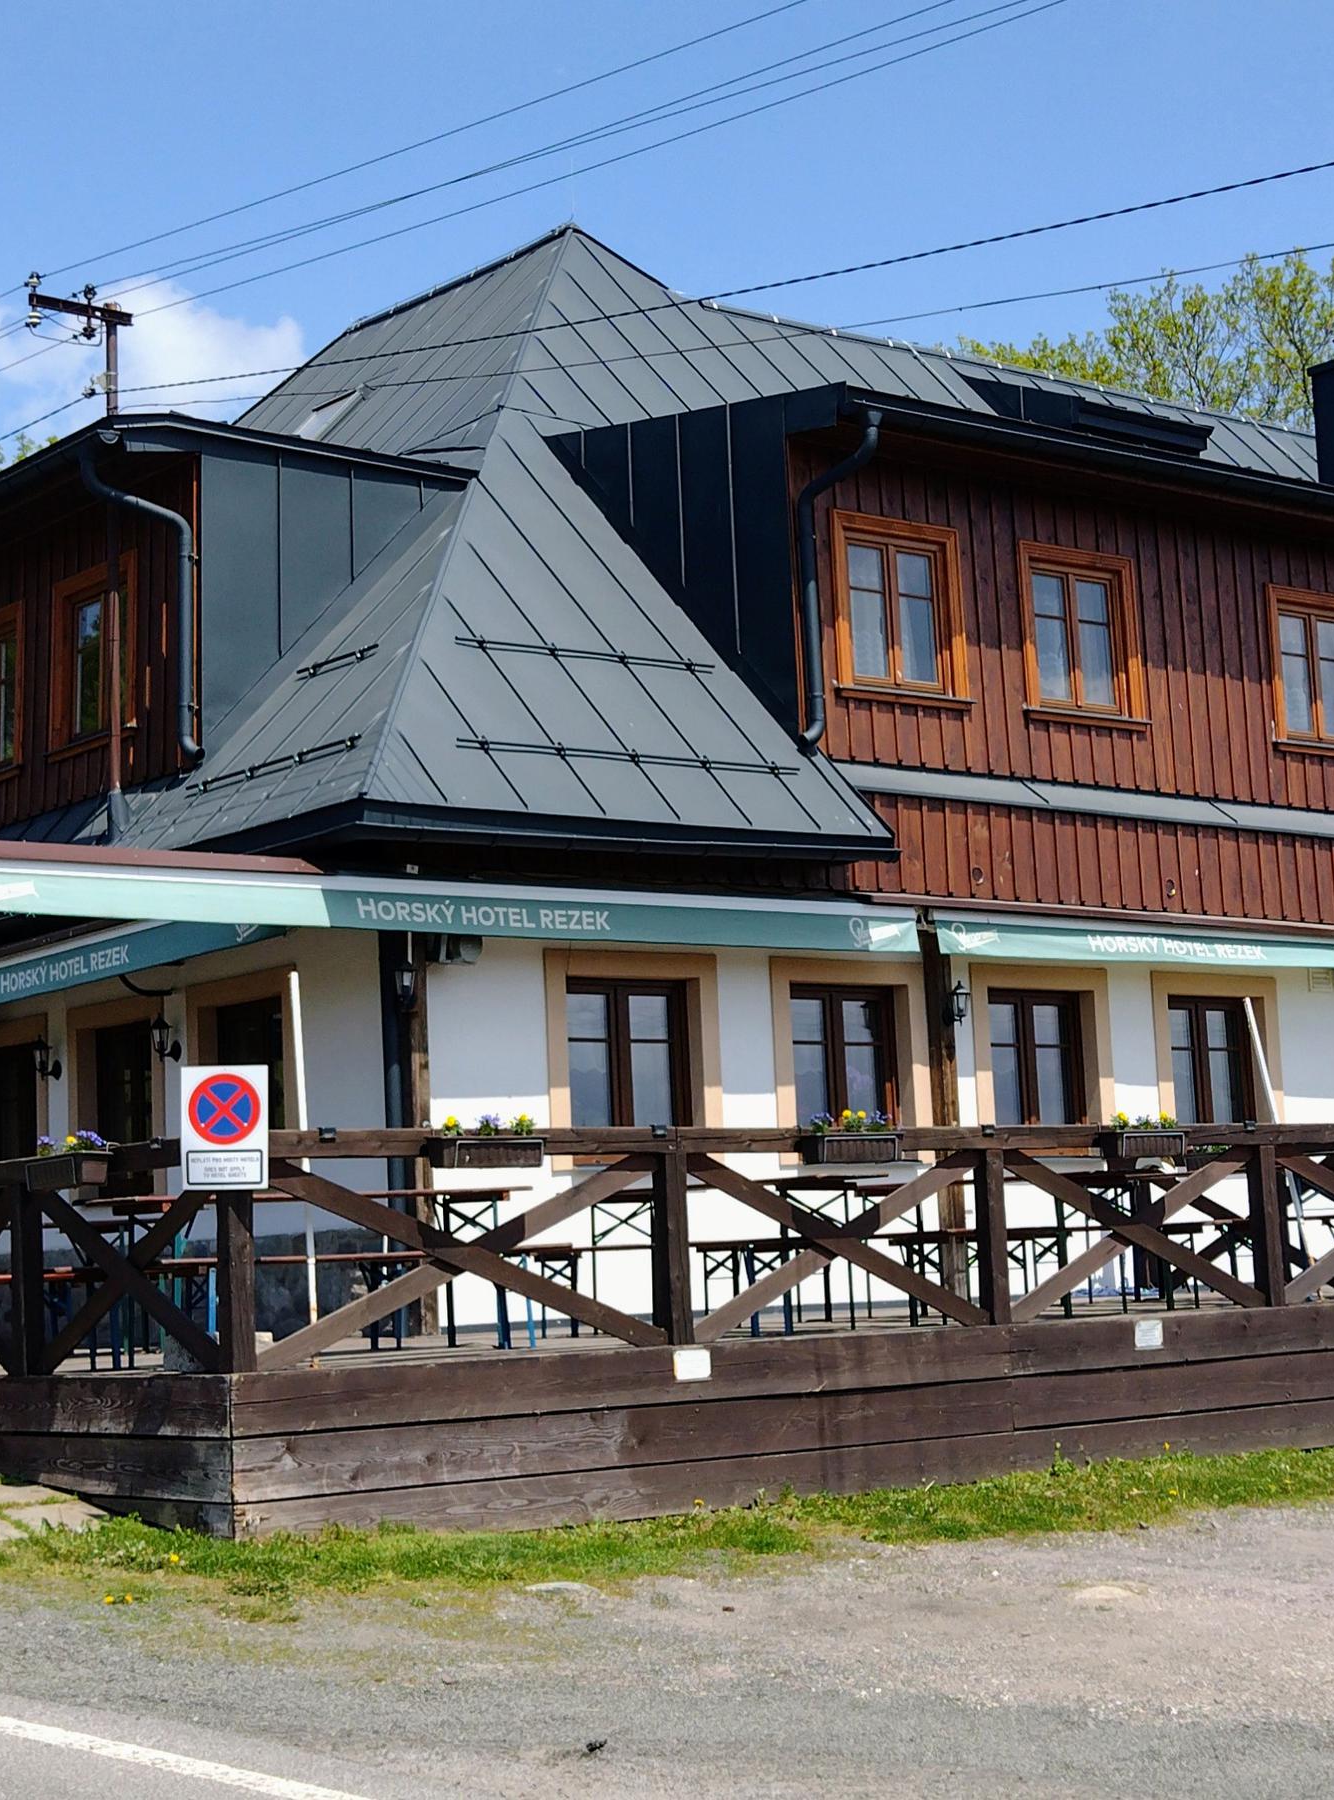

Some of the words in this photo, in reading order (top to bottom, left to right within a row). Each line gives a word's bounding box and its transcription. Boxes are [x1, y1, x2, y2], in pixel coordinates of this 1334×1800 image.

[356, 897, 455, 924] HORSKÝ
[461, 905, 536, 929] HOTEL
[539, 908, 611, 931] REZEK
[1161, 937, 1215, 957] HOTEL
[1214, 943, 1267, 960] REZEK
[0, 961, 47, 994] HORSKÝ
[49, 955, 88, 982] HOTEL
[90, 944, 130, 972] REZEK
